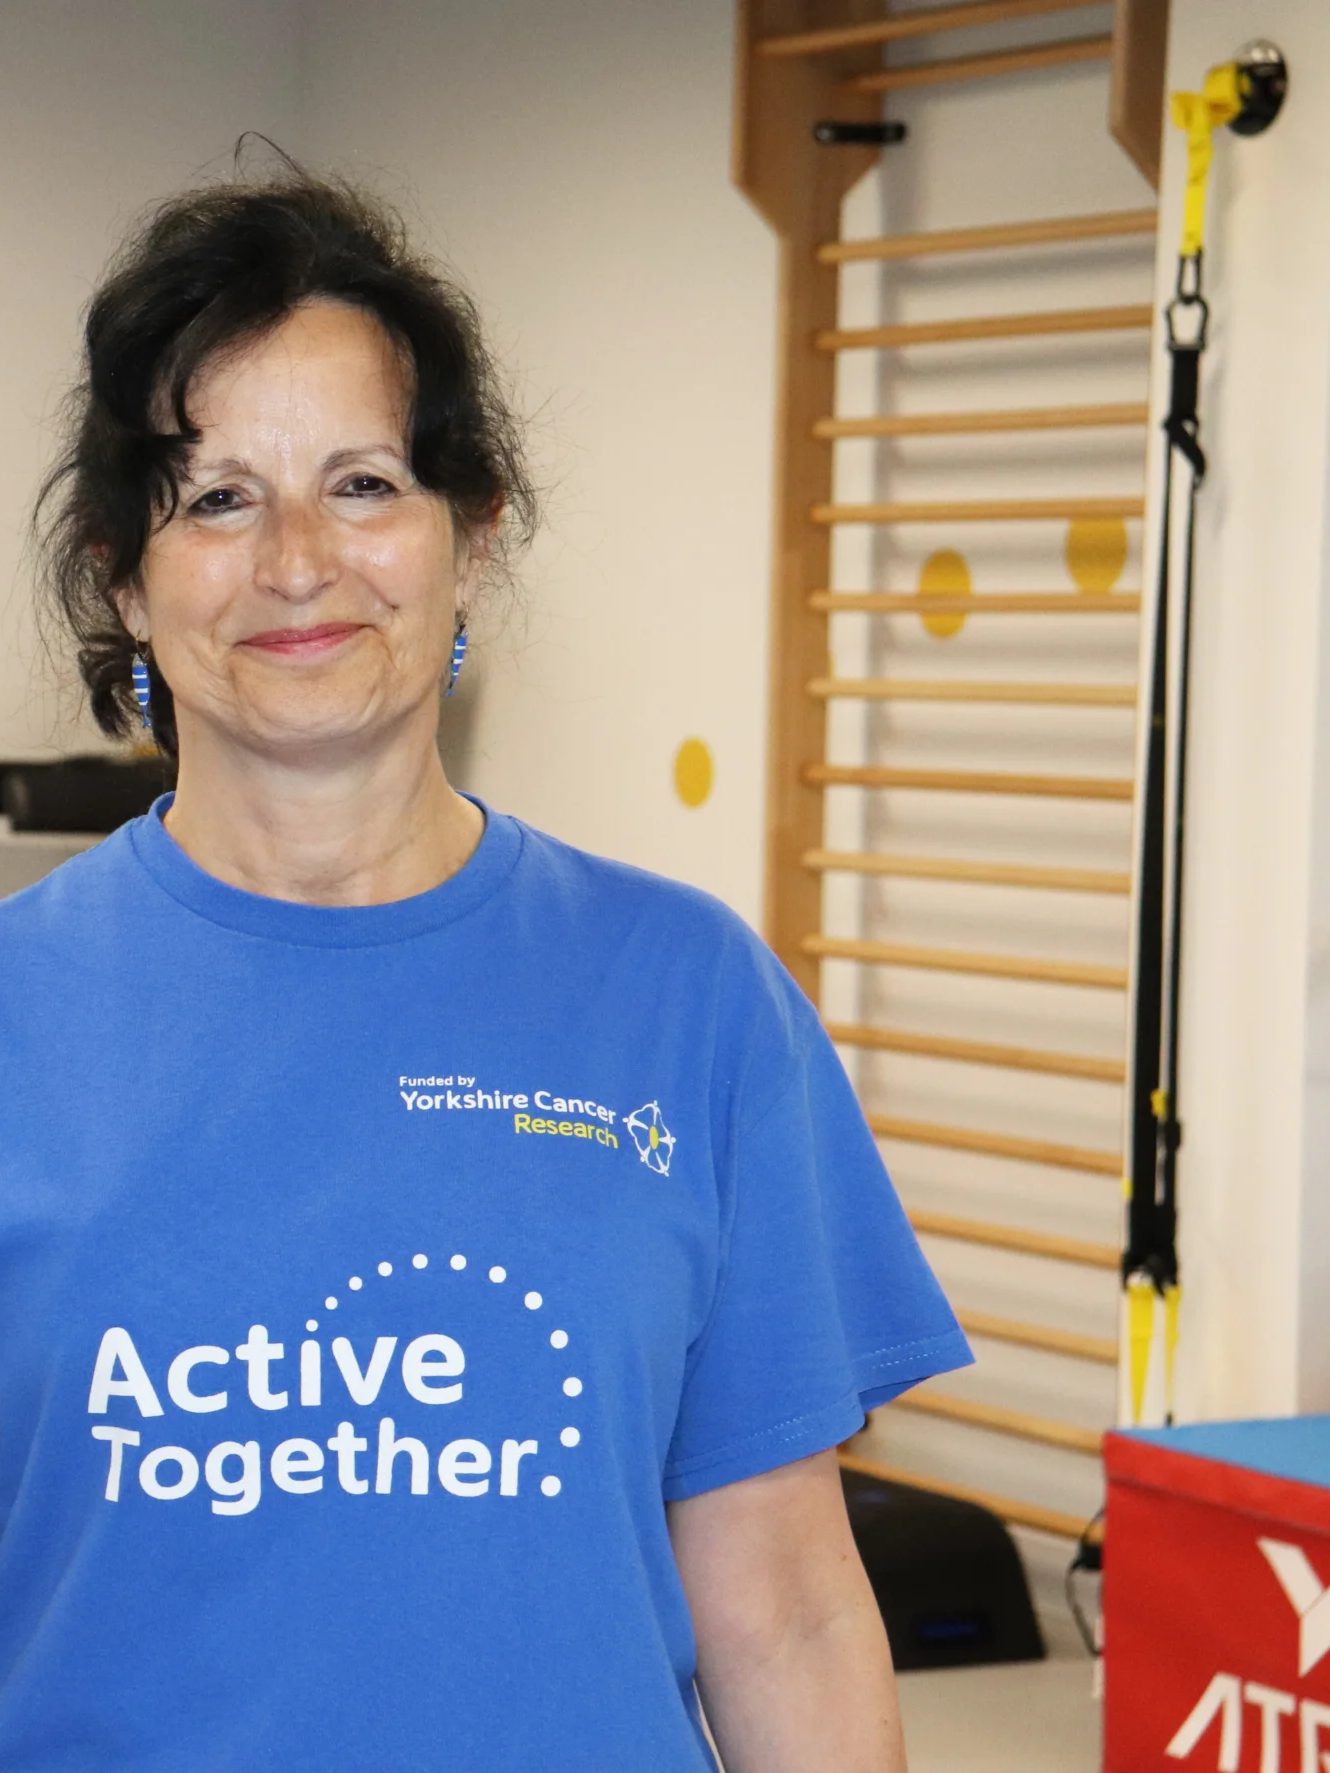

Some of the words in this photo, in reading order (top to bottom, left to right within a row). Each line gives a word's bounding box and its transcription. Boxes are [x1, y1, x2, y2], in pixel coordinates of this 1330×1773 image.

[398, 1075, 454, 1087] Funded
[457, 1075, 476, 1088] by
[399, 1089, 530, 1111] Yorkshire
[533, 1090, 618, 1126] Cancer
[513, 1113, 619, 1149] Research
[87, 1319, 466, 1418] Active
